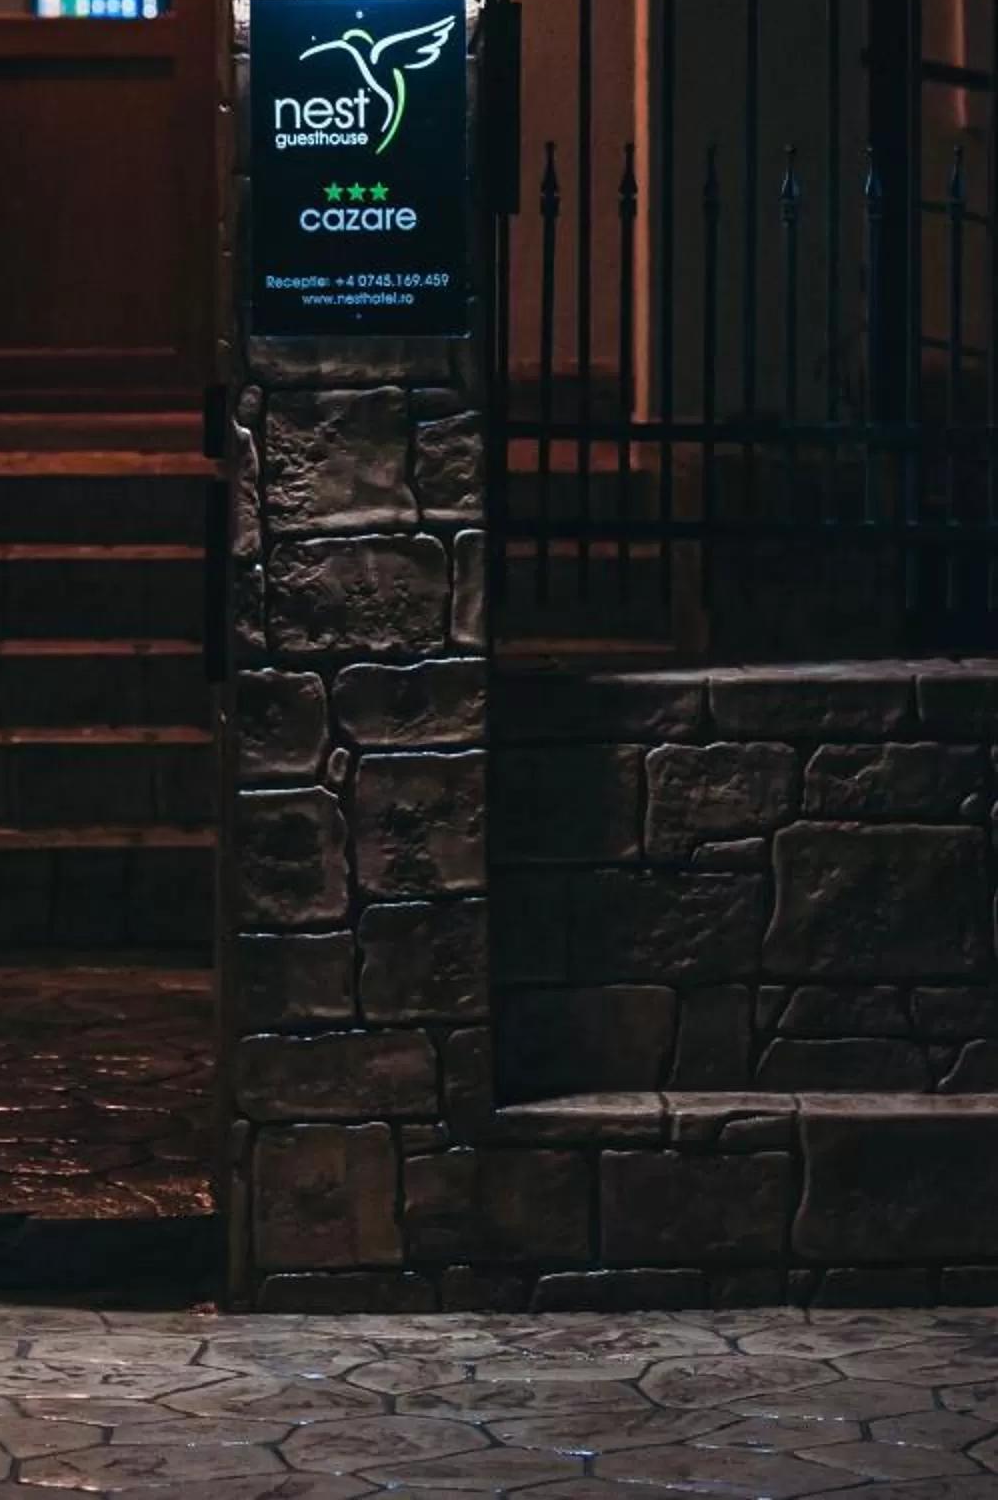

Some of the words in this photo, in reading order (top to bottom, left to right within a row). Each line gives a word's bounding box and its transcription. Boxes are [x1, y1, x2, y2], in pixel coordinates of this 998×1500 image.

[274, 88, 370, 130] nest
[274, 130, 369, 150] guesthouse
[299, 206, 418, 232] cazare
